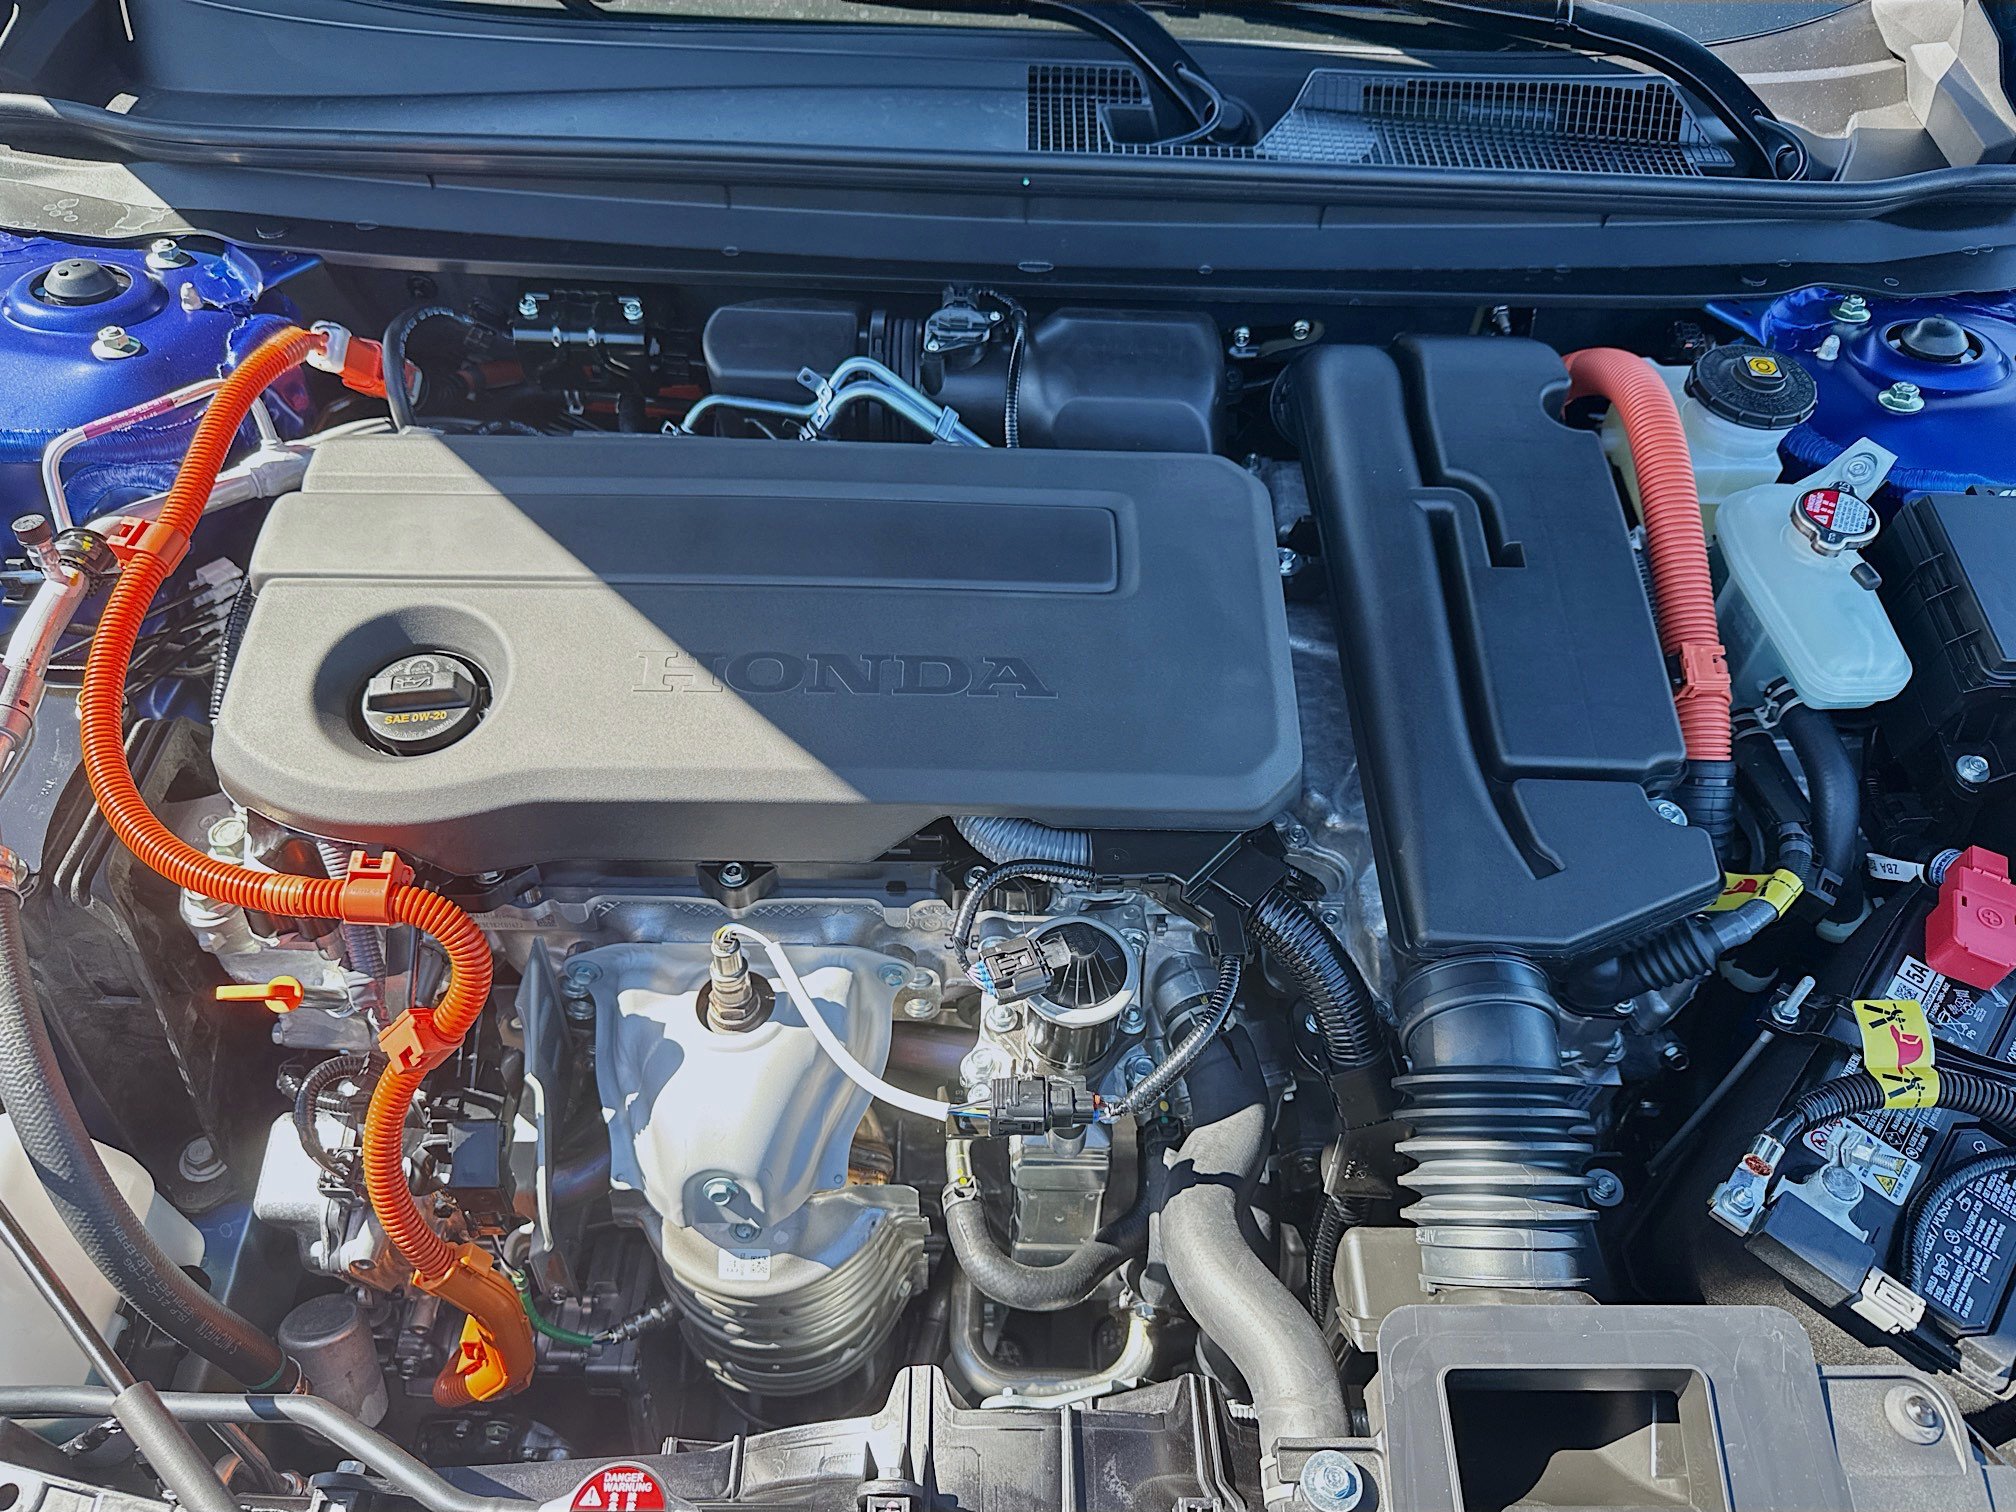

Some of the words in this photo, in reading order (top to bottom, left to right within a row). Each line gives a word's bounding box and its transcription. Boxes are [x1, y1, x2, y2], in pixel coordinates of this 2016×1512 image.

[632, 650, 1059, 699] HONDA
[384, 714, 410, 725] SAE
[411, 711, 447, 723] 0W-20
[1905, 962, 1929, 984] 5A
[1965, 1028, 1976, 1040] Pb
[603, 1472, 645, 1483] DANGER
[603, 1482, 653, 1493] WARNUNG
